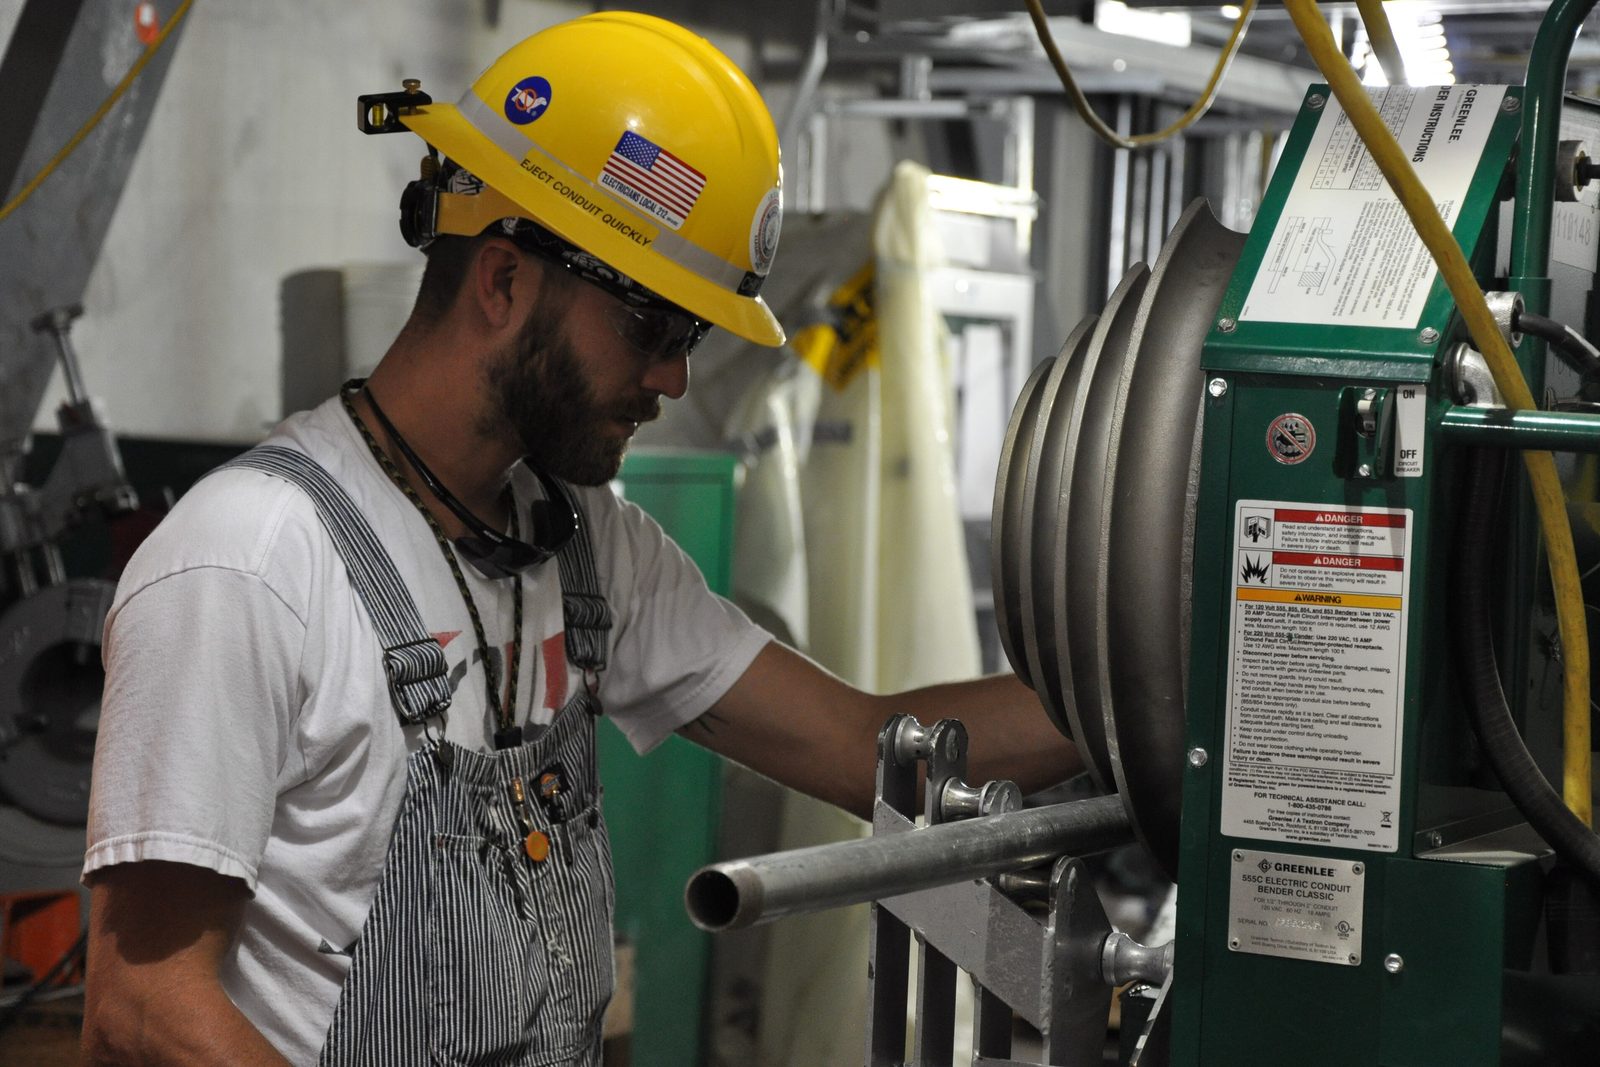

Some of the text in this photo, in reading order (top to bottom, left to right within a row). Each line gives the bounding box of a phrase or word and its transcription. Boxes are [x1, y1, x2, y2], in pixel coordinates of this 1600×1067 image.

[1448, 89, 1478, 142] GREENLEE
[1412, 103, 1446, 163] INSTRUCTIONS
[520, 158, 652, 246] EJECT CONDUIT QUICKLY
[602, 174, 668, 219] ELECTRICIANS LOCAL 212
[1402, 390, 1415, 399] ON
[1400, 450, 1417, 459] OFF
[1324, 514, 1362, 523] DANGER
[1322, 557, 1360, 566] DANGER
[1301, 594, 1341, 603] WARNING
[1268, 792, 1304, 802] TECHNICAL
[1305, 796, 1346, 805] ASSISTANCE
[1274, 862, 1335, 877] GREENLEE
[1241, 873, 1351, 893] 555C ELECTRIC CONDUIT
[1257, 885, 1334, 900] BENDER CLASSIC
[1278, 899, 1305, 908] THROUGH
[1312, 903, 1338, 911] CONDUIT
